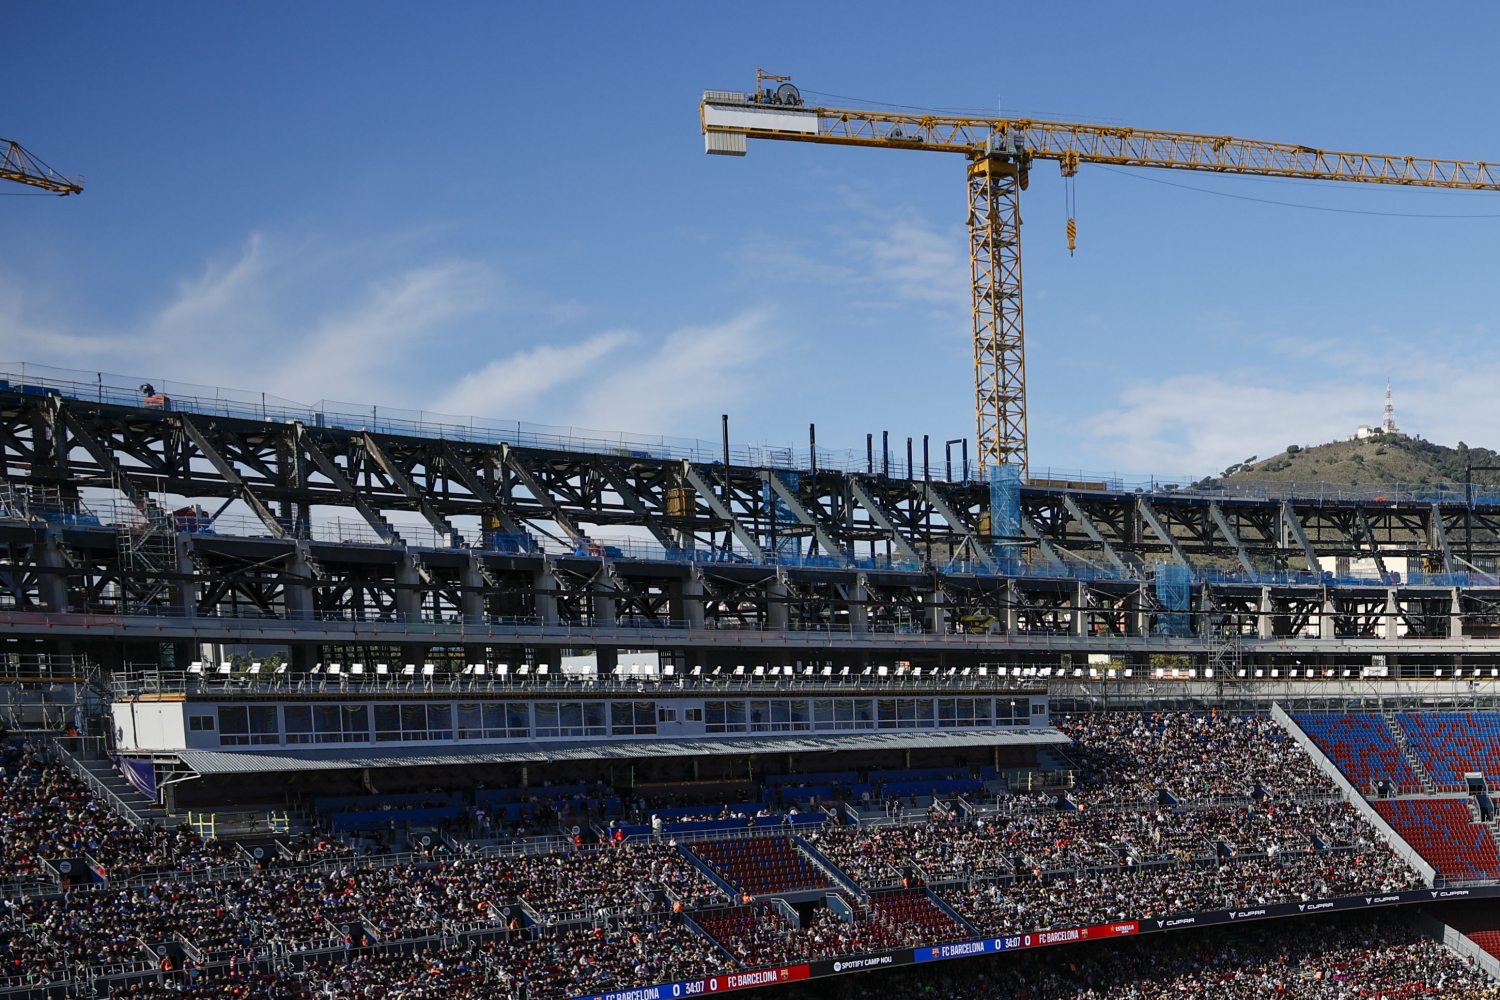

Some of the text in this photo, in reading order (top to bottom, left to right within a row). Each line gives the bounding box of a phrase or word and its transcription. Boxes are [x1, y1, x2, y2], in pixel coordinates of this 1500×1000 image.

[1374, 896, 1400, 904] CUPRA
[1307, 902, 1334, 910] CUPRA
[1238, 910, 1265, 918] CUPRA
[1166, 917, 1195, 926] CUPRA
[941, 930, 1079, 957] FC BARCELONA 0 34:07 0 FC BARCELONA
[841, 956, 892, 970] SPOTIFY CAMP NOU
[672, 983, 680, 997] 0
[685, 981, 705, 994] 34:07
[710, 978, 718, 991] 0
[728, 977, 737, 988] FC
[738, 970, 777, 987] BARCELONA
